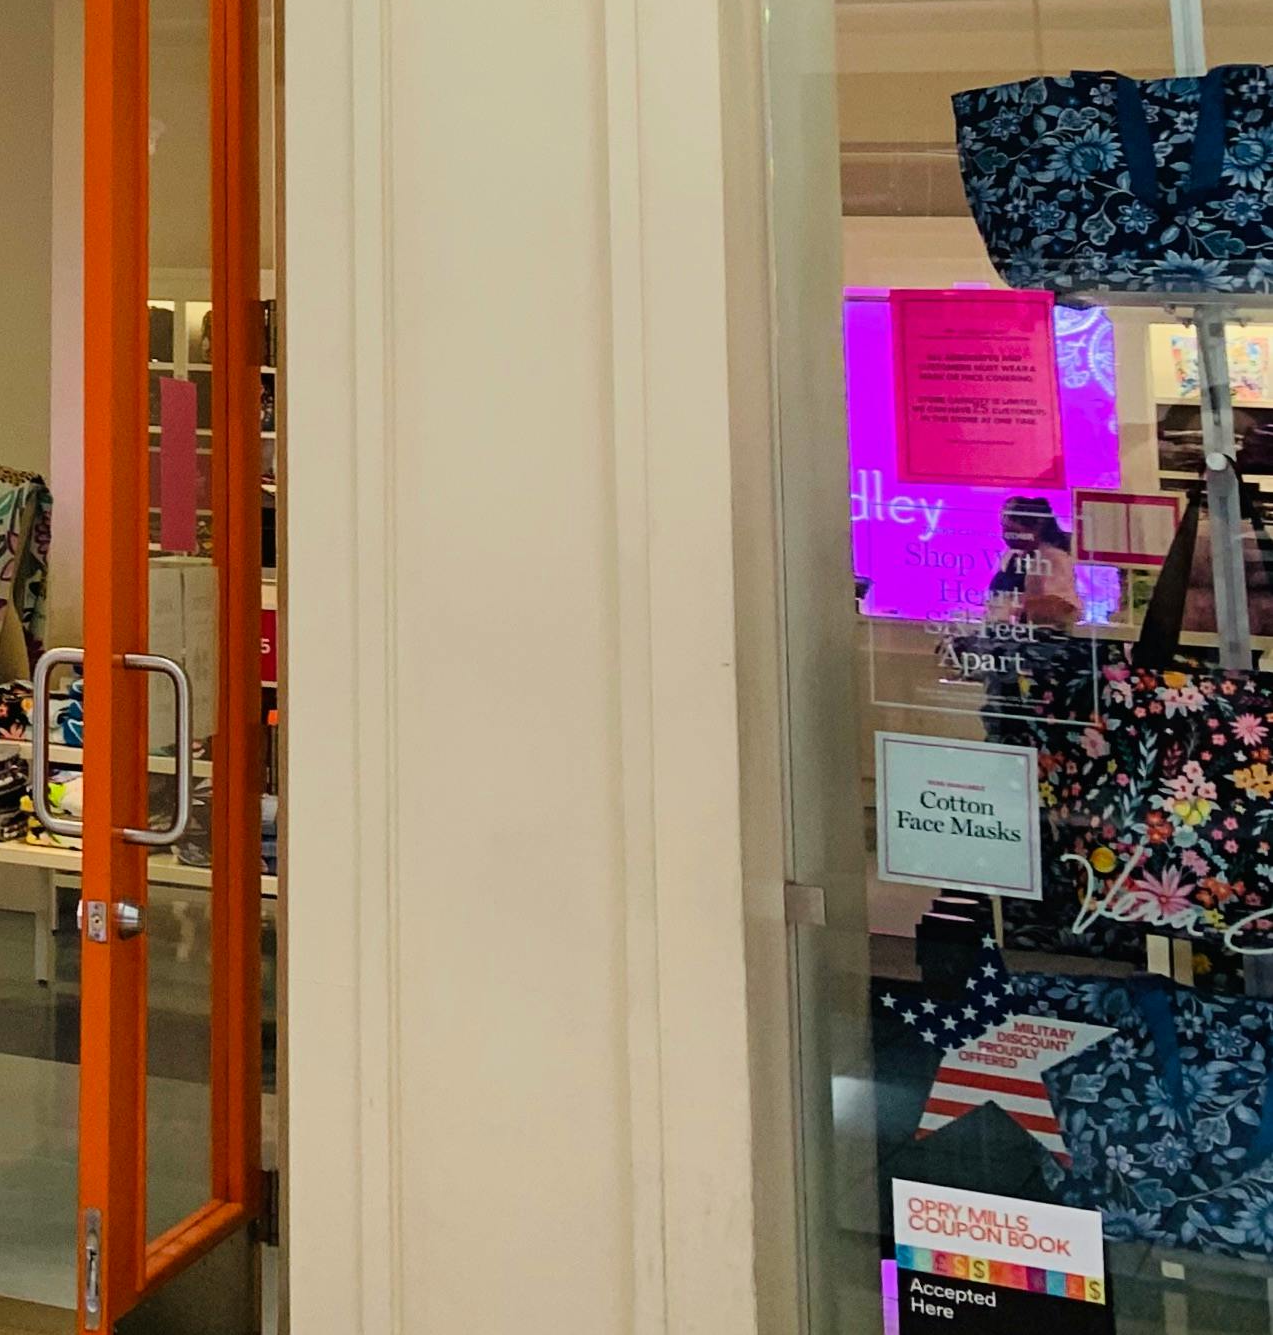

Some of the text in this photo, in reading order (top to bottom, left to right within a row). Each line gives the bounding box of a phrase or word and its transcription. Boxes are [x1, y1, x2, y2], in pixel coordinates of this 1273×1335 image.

[905, 541, 1053, 576] Shop With
[939, 642, 1032, 677] Apart
[920, 790, 995, 816] Cotton
[897, 810, 1022, 842] Face Masks
[1059, 844, 1205, 938] Vera
[996, 1031, 1070, 1052] DISCOUNT
[1014, 1021, 1077, 1041] MILITARY
[958, 1050, 1018, 1069] OFFERED
[978, 1041, 1040, 1061] PROUDLY
[908, 1197, 1029, 1232] OPRY MILLS
[909, 1214, 1072, 1257] COUPON BOOK
[910, 1277, 997, 1309] Accepted
[911, 1297, 955, 1320] Here
